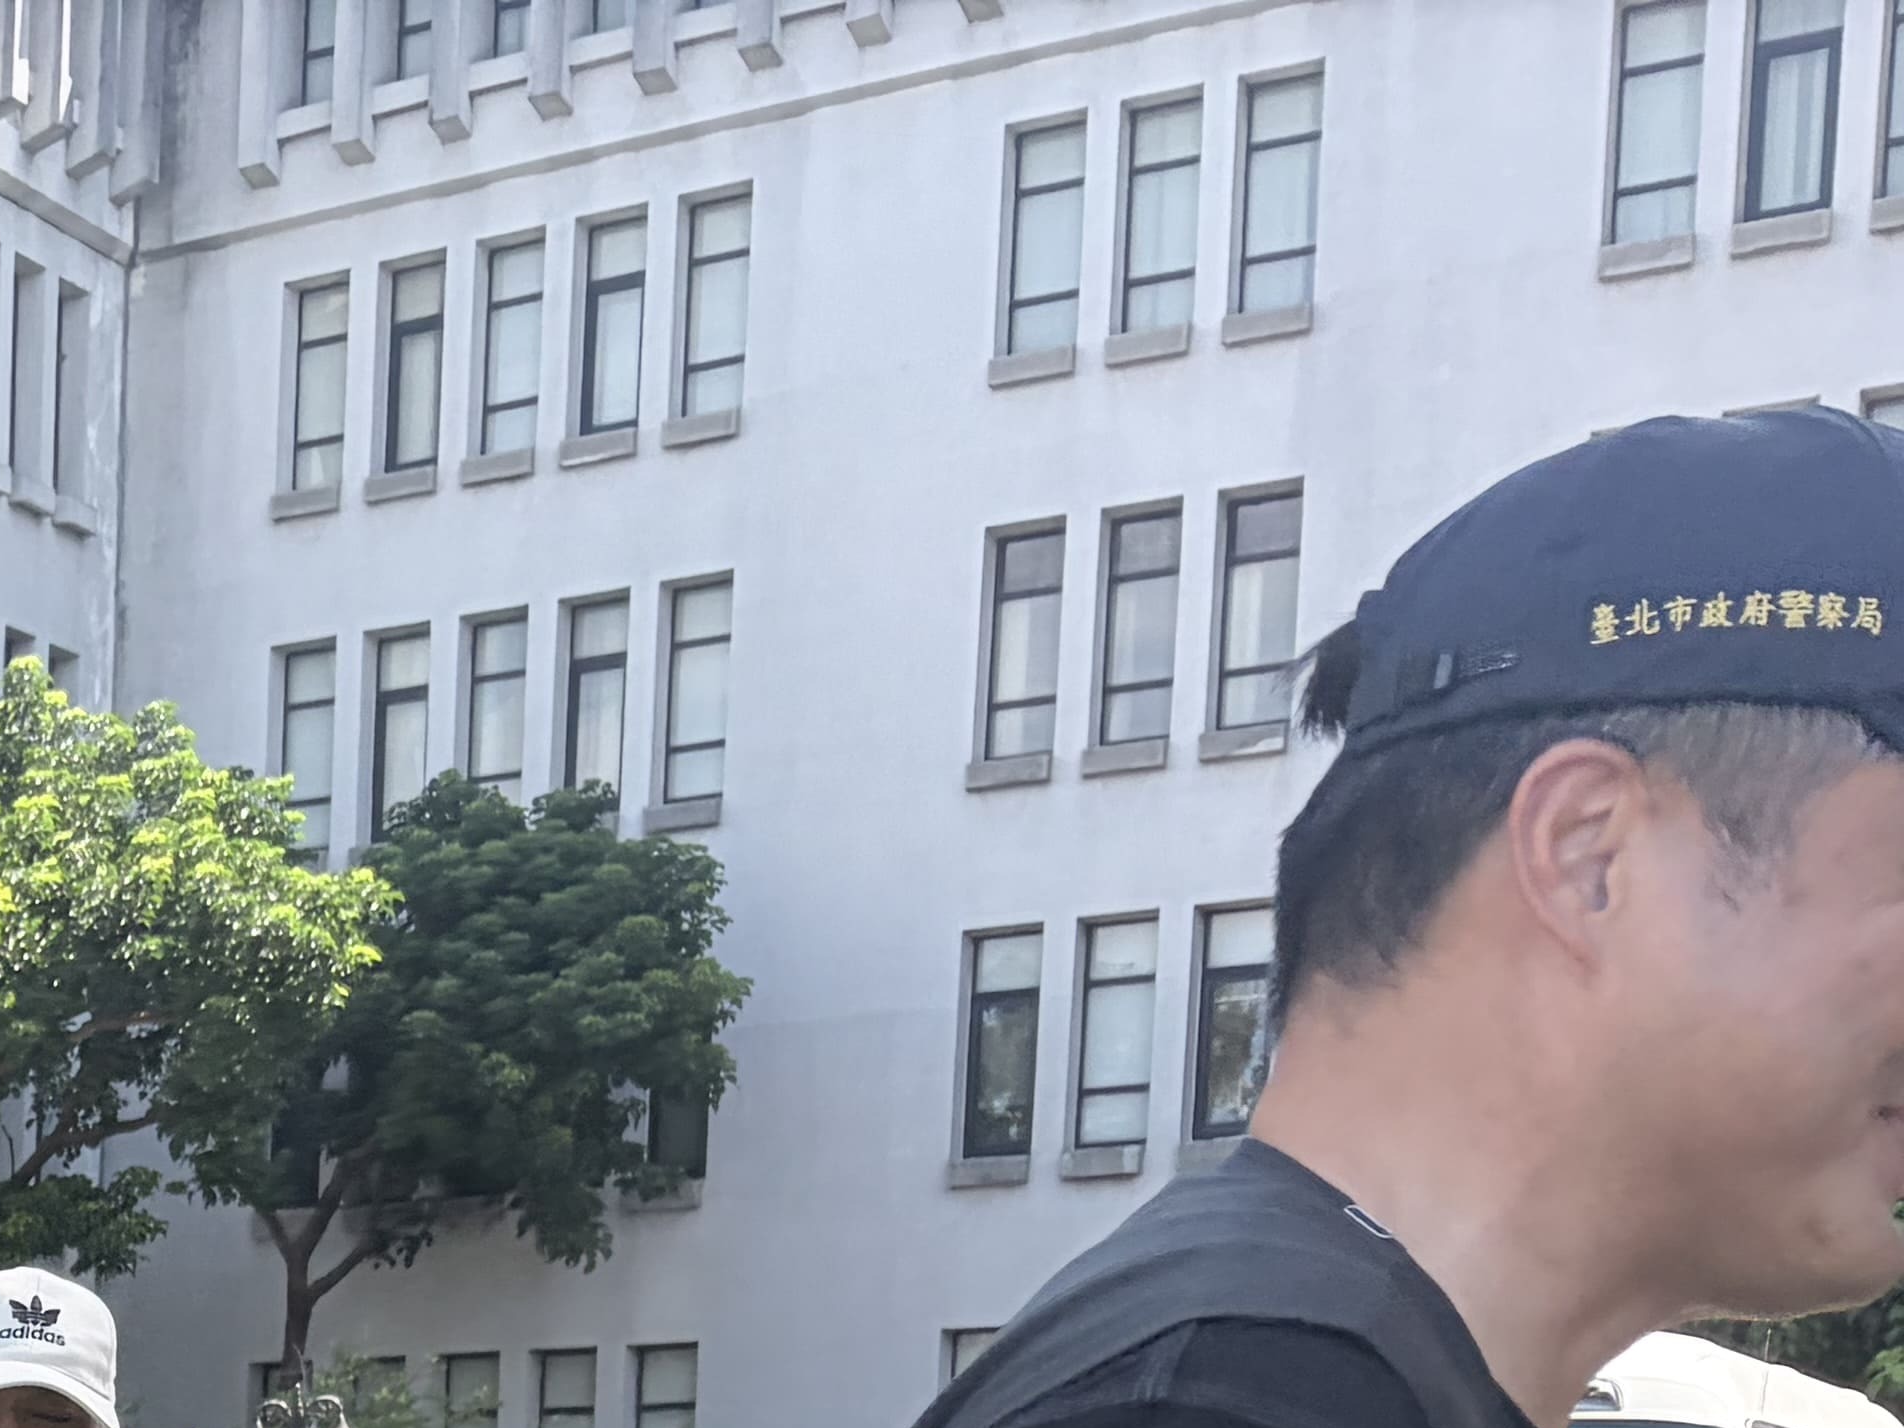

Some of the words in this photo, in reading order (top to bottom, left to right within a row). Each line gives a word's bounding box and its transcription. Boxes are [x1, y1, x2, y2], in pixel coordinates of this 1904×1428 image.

[1591, 590, 1882, 645] 臺北市政府警察局
